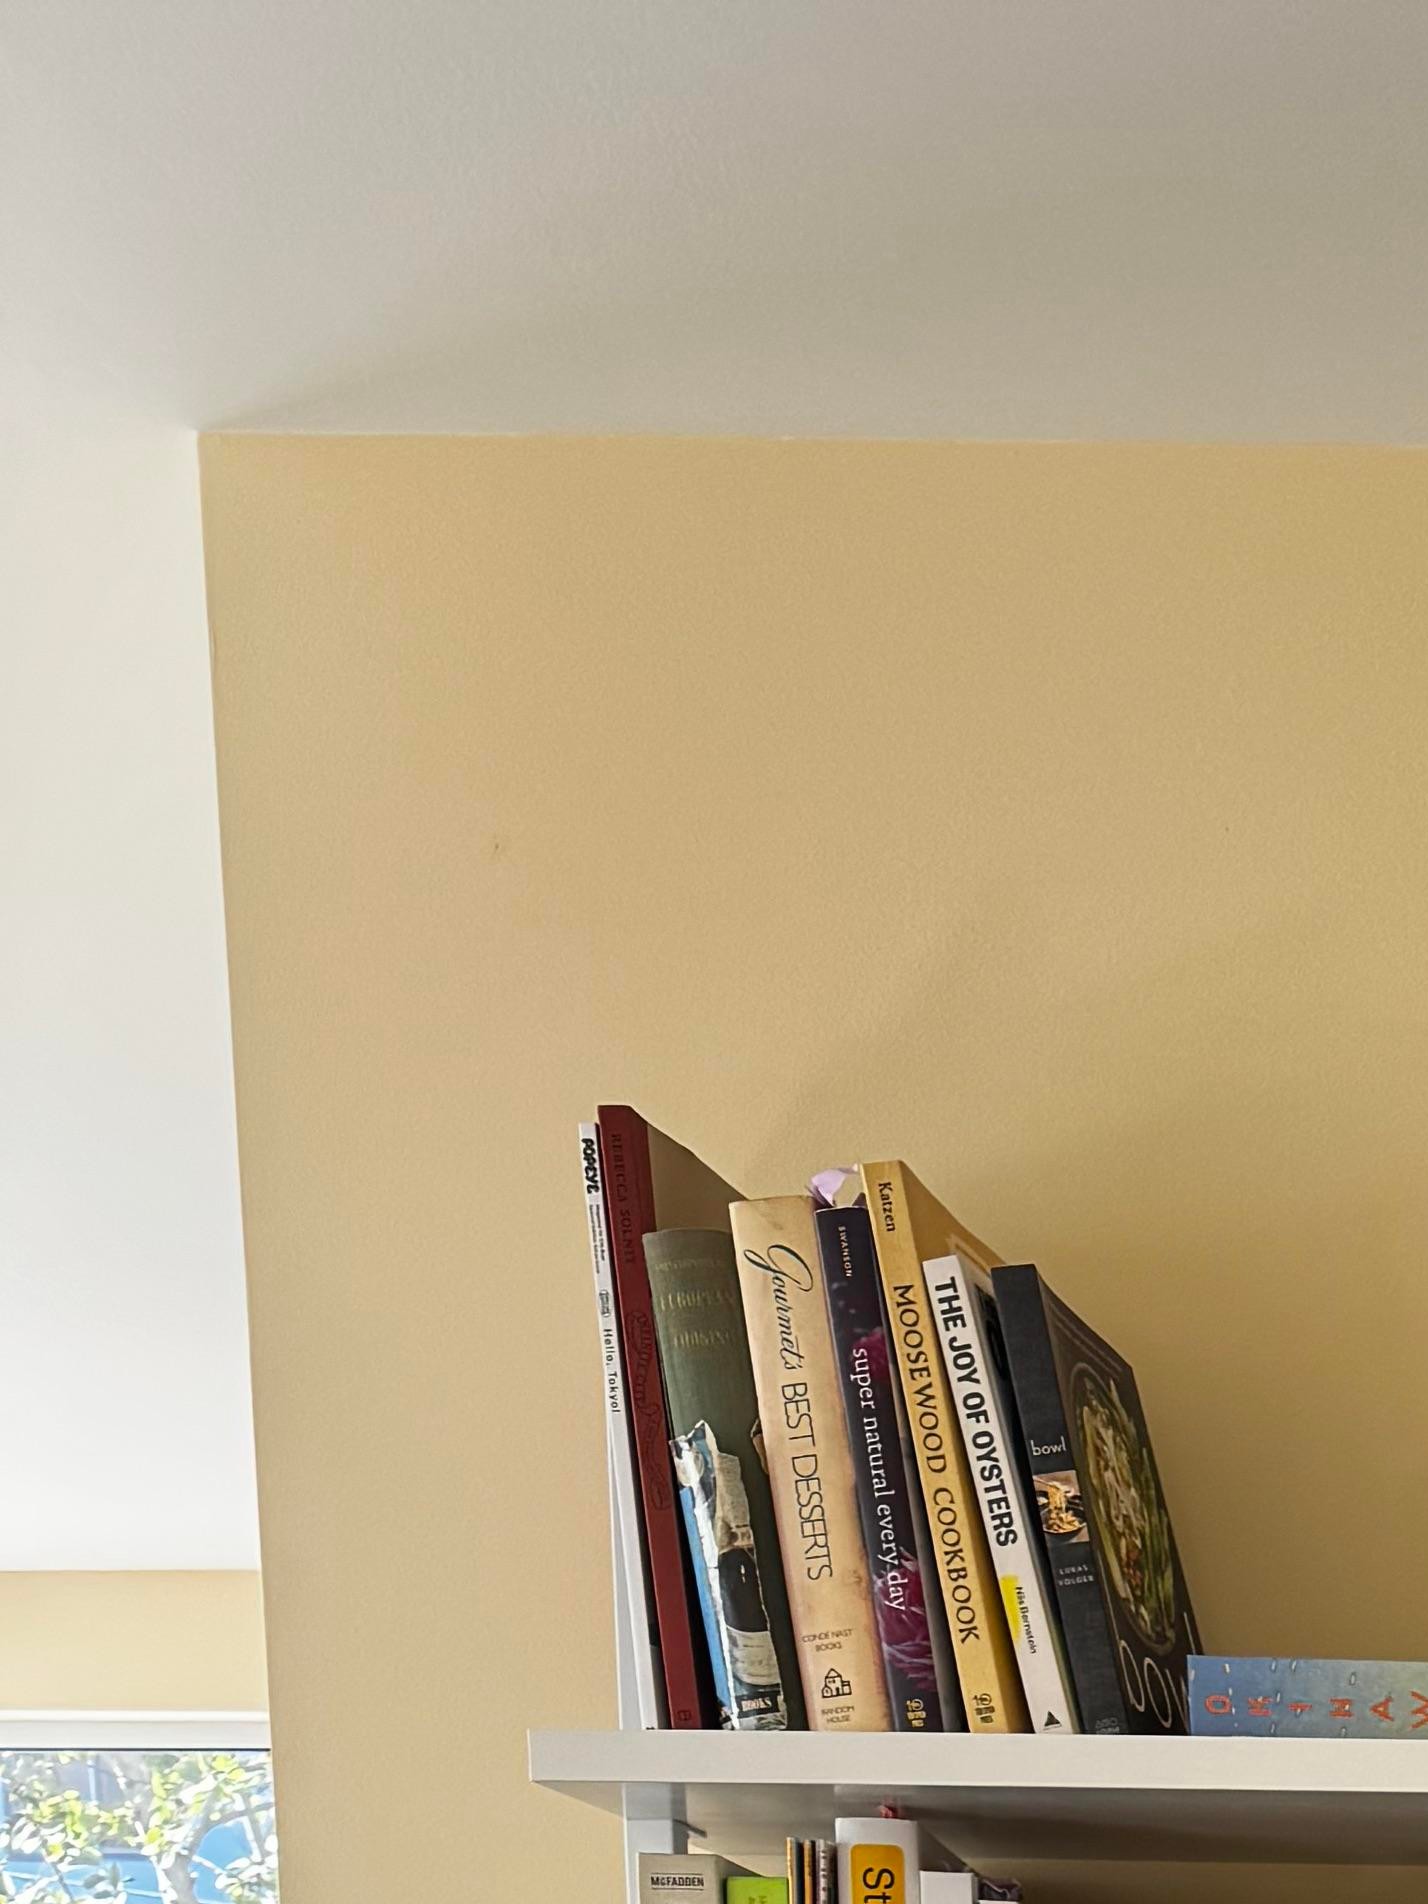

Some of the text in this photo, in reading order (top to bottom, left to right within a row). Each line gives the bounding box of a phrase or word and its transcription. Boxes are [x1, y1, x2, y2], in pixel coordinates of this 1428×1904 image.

[877, 1180, 897, 1234] Katzen
[780, 1381, 816, 1447] BEST
[933, 1275, 1018, 1547] THE JOY OF OYSTERS
[1031, 1437, 1067, 1457] bowl
[893, 1283, 982, 1644] MOOSEWOOD COOKBOOK
[791, 1455, 834, 1582] DESSERTS
